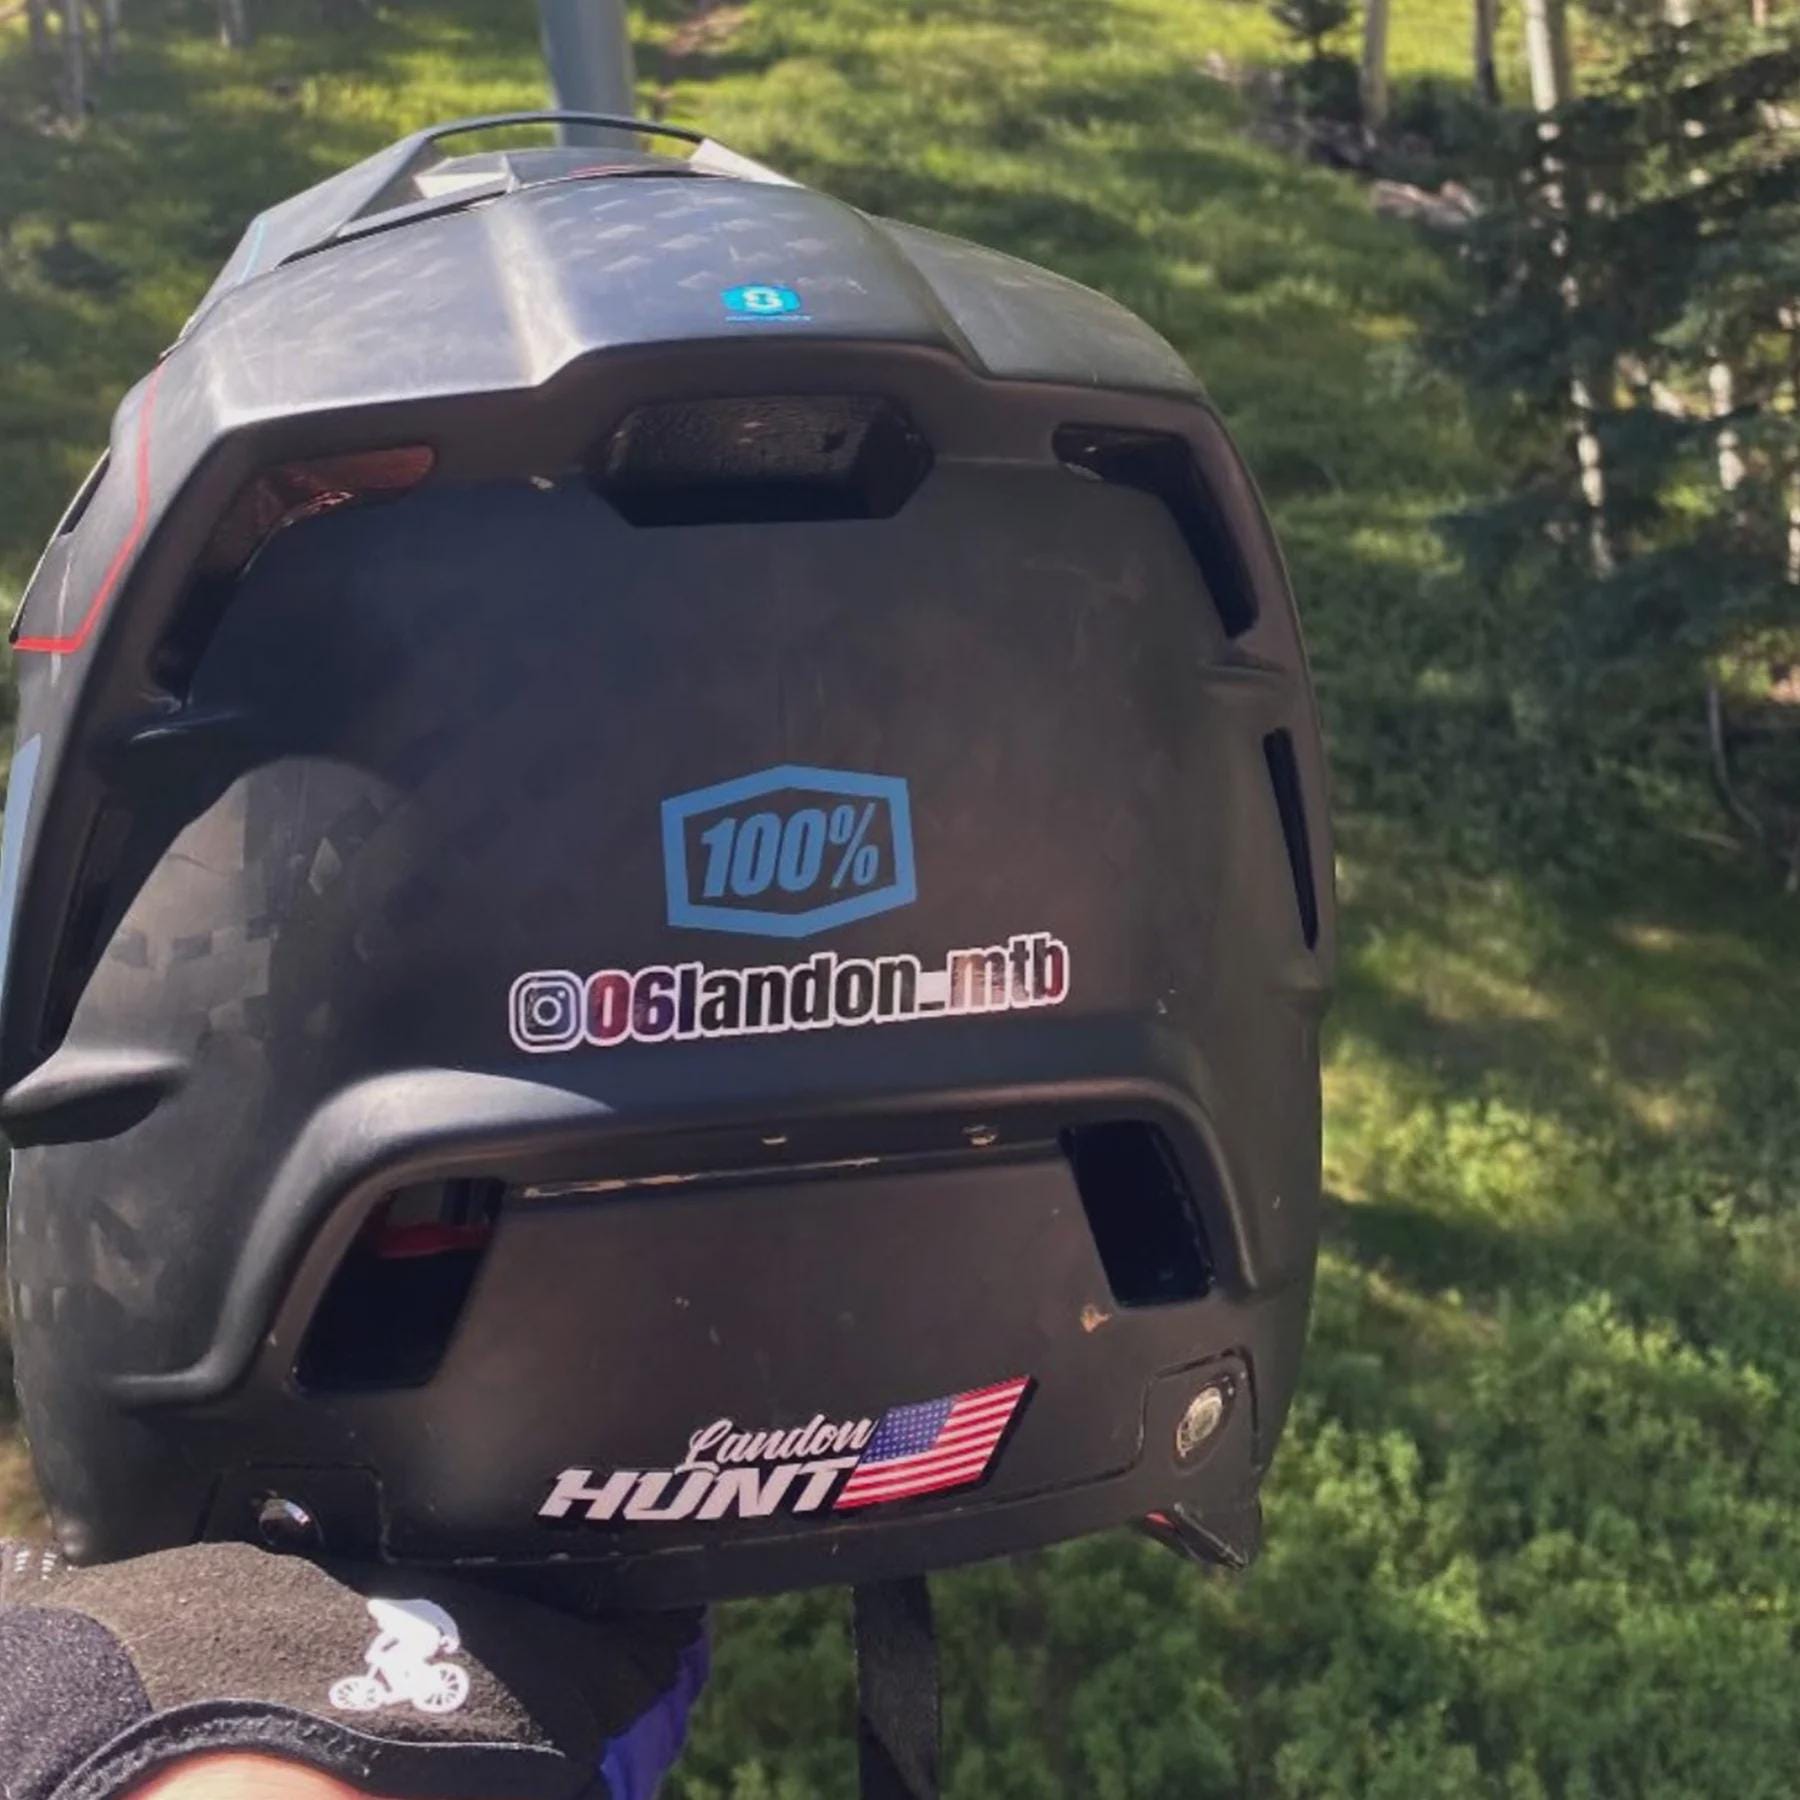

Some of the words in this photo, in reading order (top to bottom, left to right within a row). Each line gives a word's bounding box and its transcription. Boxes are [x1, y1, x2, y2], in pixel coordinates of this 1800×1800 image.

[702, 803, 880, 898] 100%
[585, 934, 1069, 1045] 06landon_mtb
[675, 1413, 878, 1474] Landon
[538, 1456, 860, 1521] HUNT
